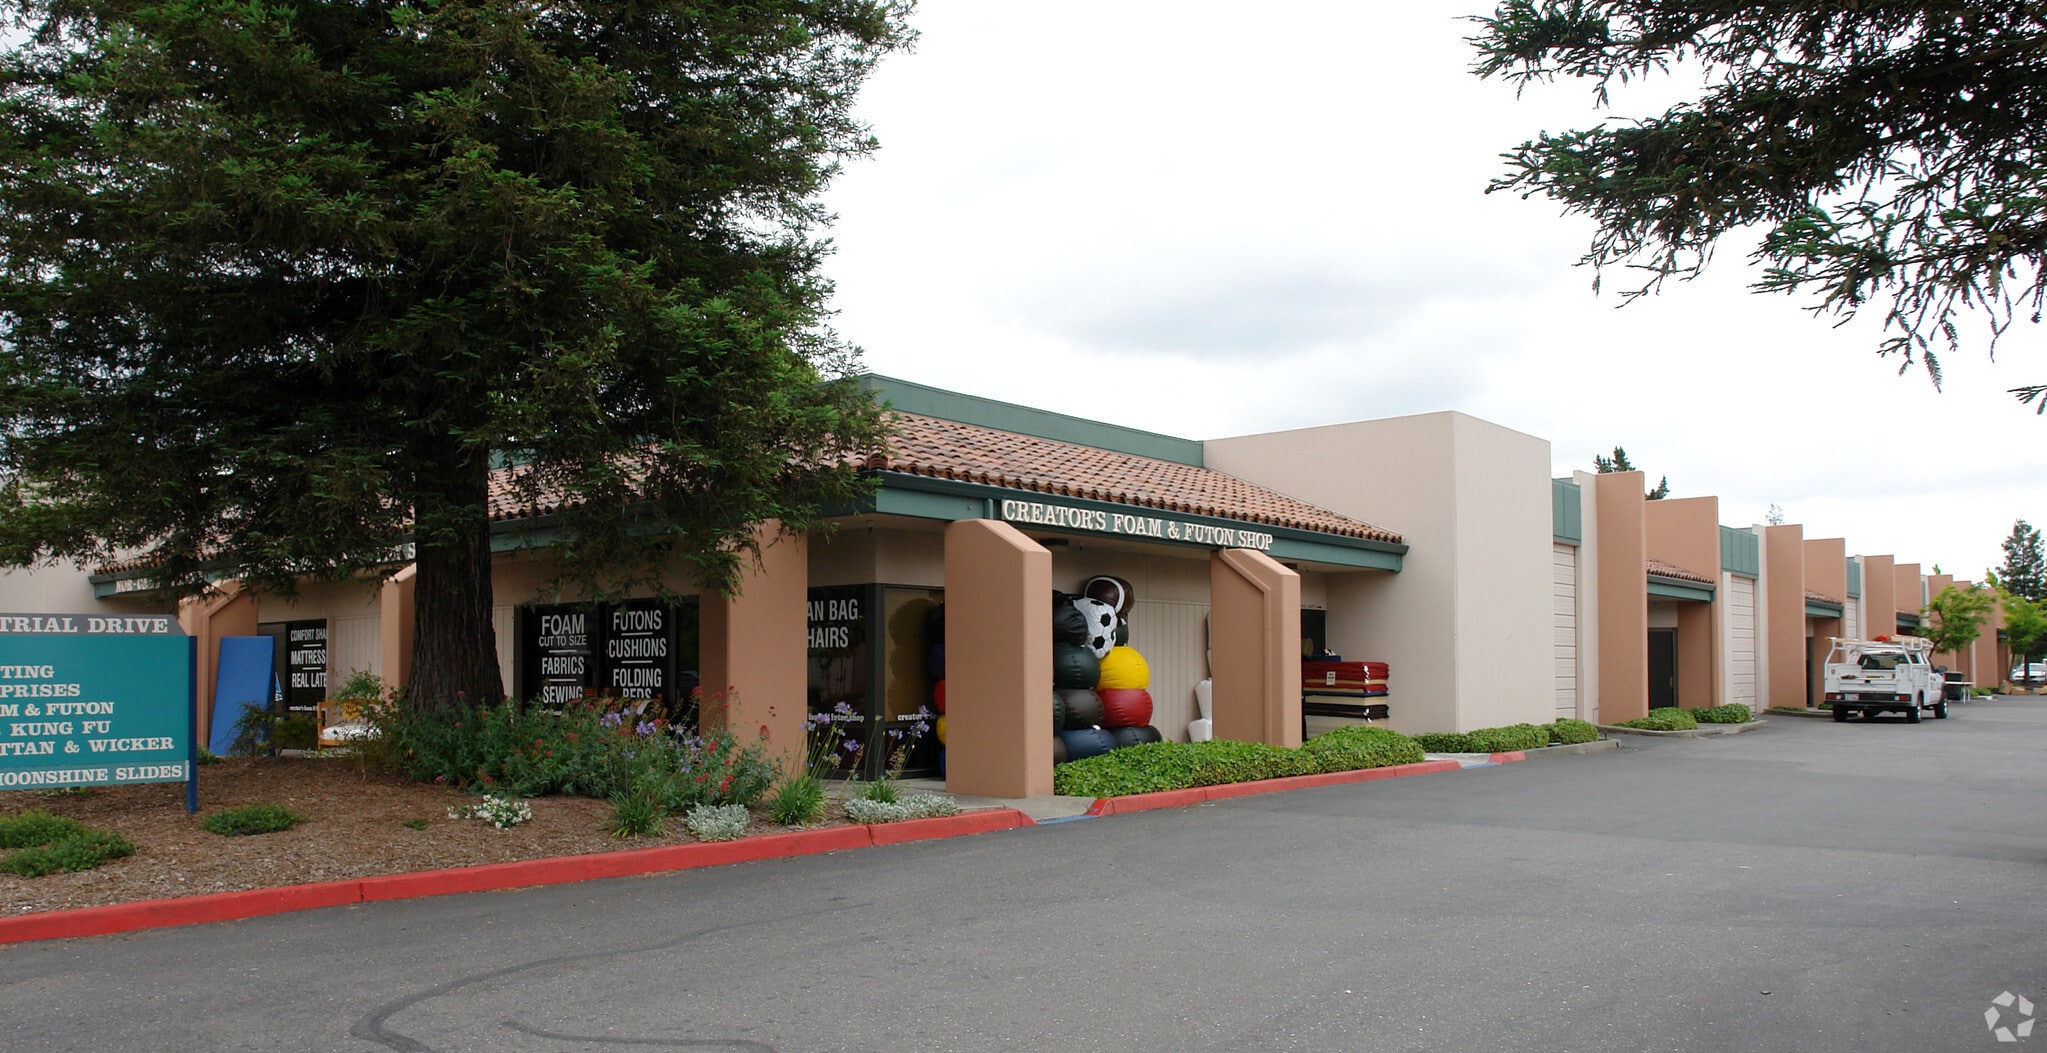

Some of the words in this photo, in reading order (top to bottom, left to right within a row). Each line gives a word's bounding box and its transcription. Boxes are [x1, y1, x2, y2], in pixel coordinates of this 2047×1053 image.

[1002, 500, 1106, 530] CREATOR'S
[1112, 514, 1163, 537] FOAM
[1168, 521, 1180, 539] &
[1184, 523, 1235, 547] FUTON
[1238, 530, 1273, 550] SHOP
[829, 598, 858, 621] BAG
[88, 618, 168, 633] DRIVE
[541, 613, 585, 635] FOAM
[613, 609, 662, 631] FUTONS
[291, 628, 315, 642] COMFORT
[538, 635, 554, 647] CUT
[556, 635, 567, 646] TO
[569, 634, 587, 646] SIZE
[608, 638, 667, 658] CUSHIONS
[291, 649, 326, 665] MATTRESS
[541, 656, 585, 675] FABRICS
[0, 665, 55, 679] TING
[292, 672, 309, 688] REAL
[613, 668, 662, 687] FOLDING
[0, 683, 81, 698] PRISES
[543, 685, 583, 704] SEWING
[25, 703, 41, 717] &
[46, 702, 115, 716] FUTON
[10, 721, 74, 737] KUNG
[82, 720, 111, 734] FU
[64, 740, 80, 754] &
[88, 737, 175, 752] WICKER
[115, 765, 183, 781] SLIDES
